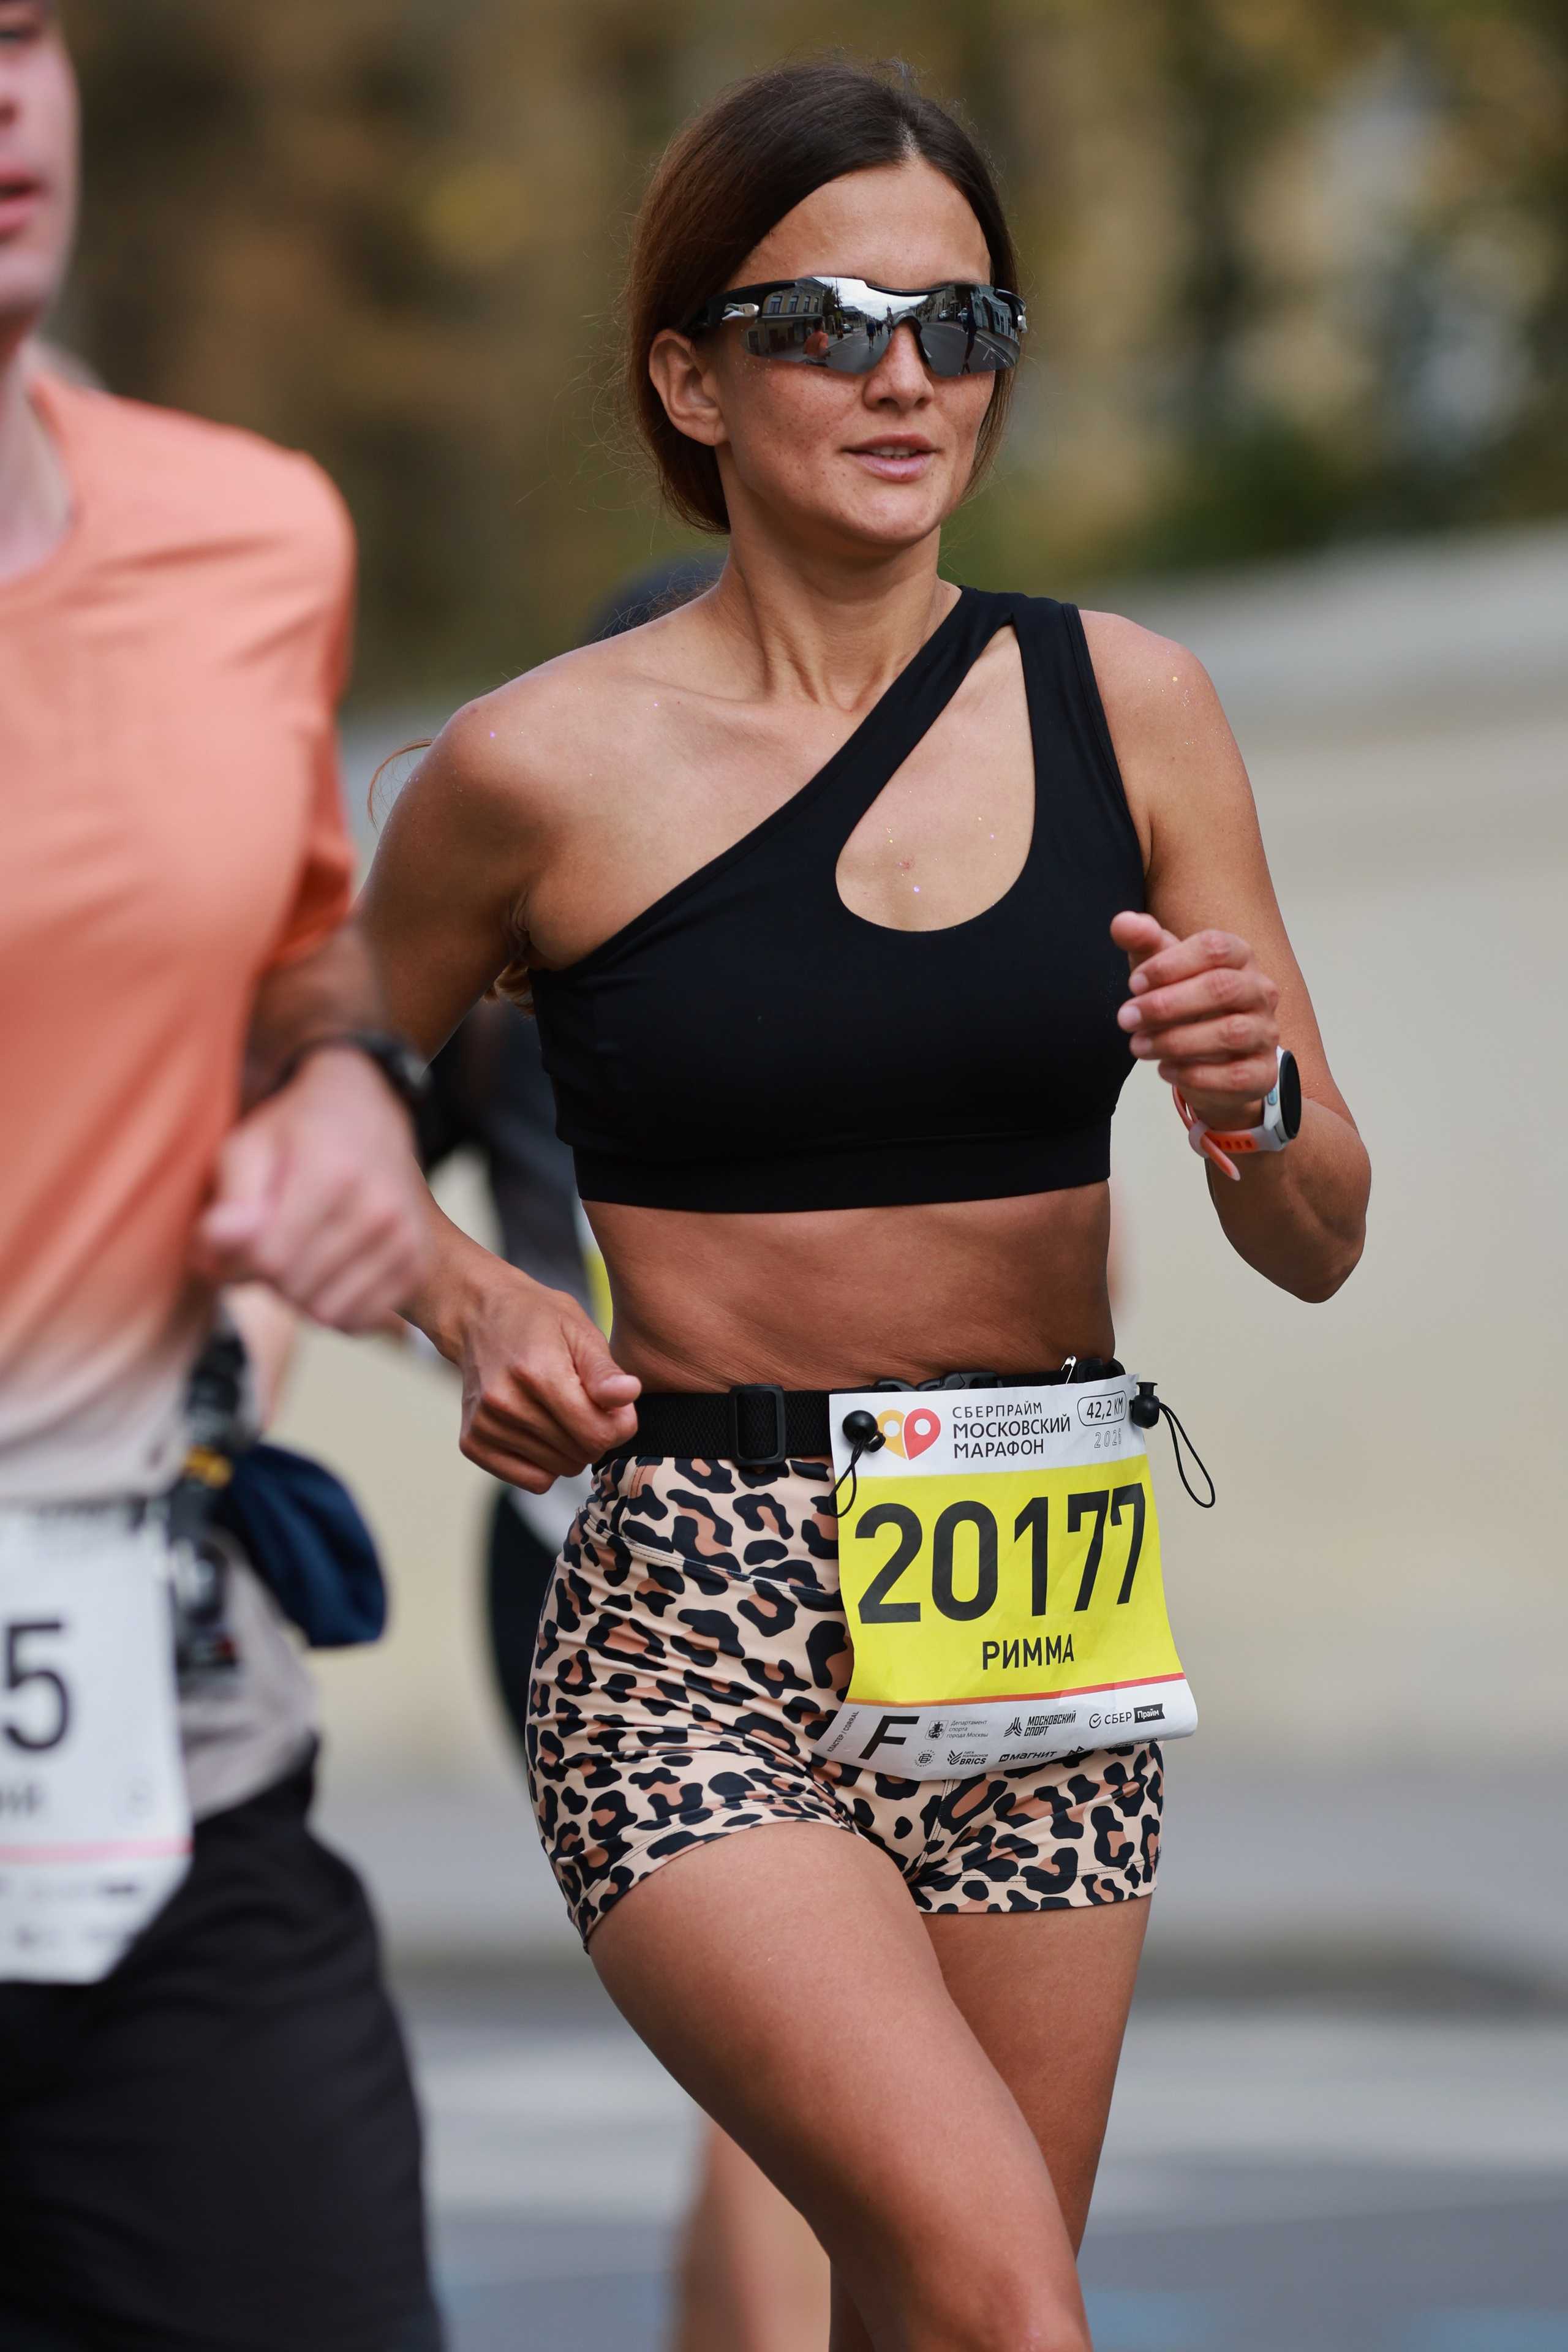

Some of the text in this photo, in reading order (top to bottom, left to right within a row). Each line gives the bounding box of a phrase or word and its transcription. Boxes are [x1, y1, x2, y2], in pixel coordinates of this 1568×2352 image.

[952, 1400, 1042, 1419] СБЕРПРАЙМ
[1086, 1400, 1112, 1420] 42,2
[952, 1413, 1071, 1439] МОСКОВСКИЙ
[954, 1438, 1044, 1459] МАРАФОН
[854, 1482, 1146, 1624] 20177
[982, 1633, 1074, 1670] РИММА
[1027, 1710, 1077, 1727] МОСКОВСКИЙ
[1104, 1708, 1160, 1725] СБЕР Прайм
[826, 1734, 844, 1752] КЛАСТЕР
[843, 1711, 859, 1732] CORRAL
[858, 1715, 921, 1760] F
[1023, 1726, 1049, 1736] СПОРТ
